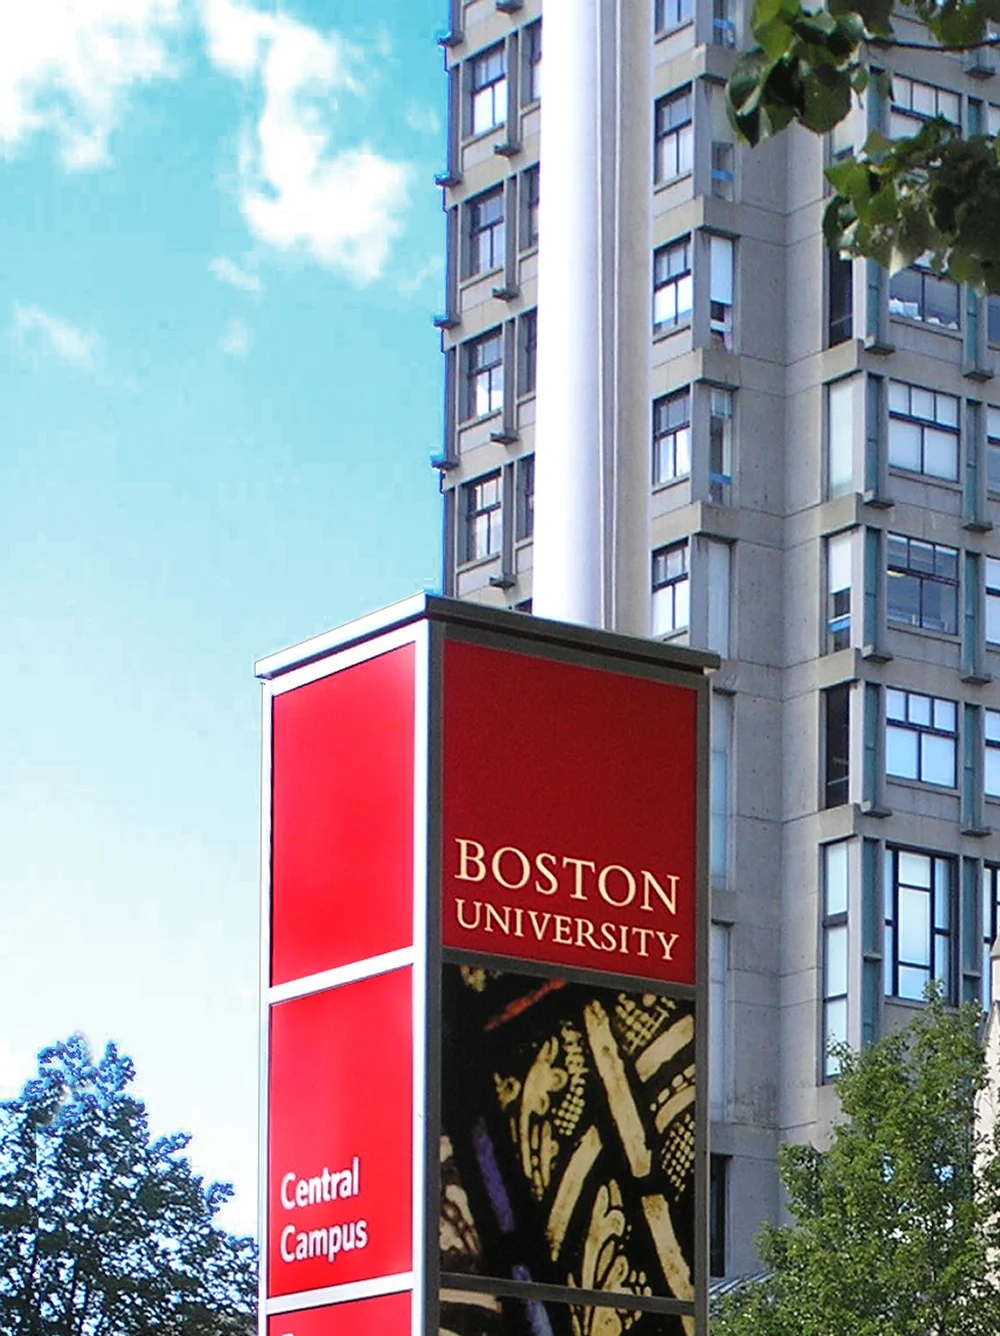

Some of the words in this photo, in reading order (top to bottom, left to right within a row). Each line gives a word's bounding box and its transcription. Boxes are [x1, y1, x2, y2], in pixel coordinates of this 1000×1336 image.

[454, 838, 680, 915] BOSTON
[454, 898, 679, 961] UNIVERSITY
[281, 1156, 359, 1210] Central
[280, 1220, 368, 1263] Campus
